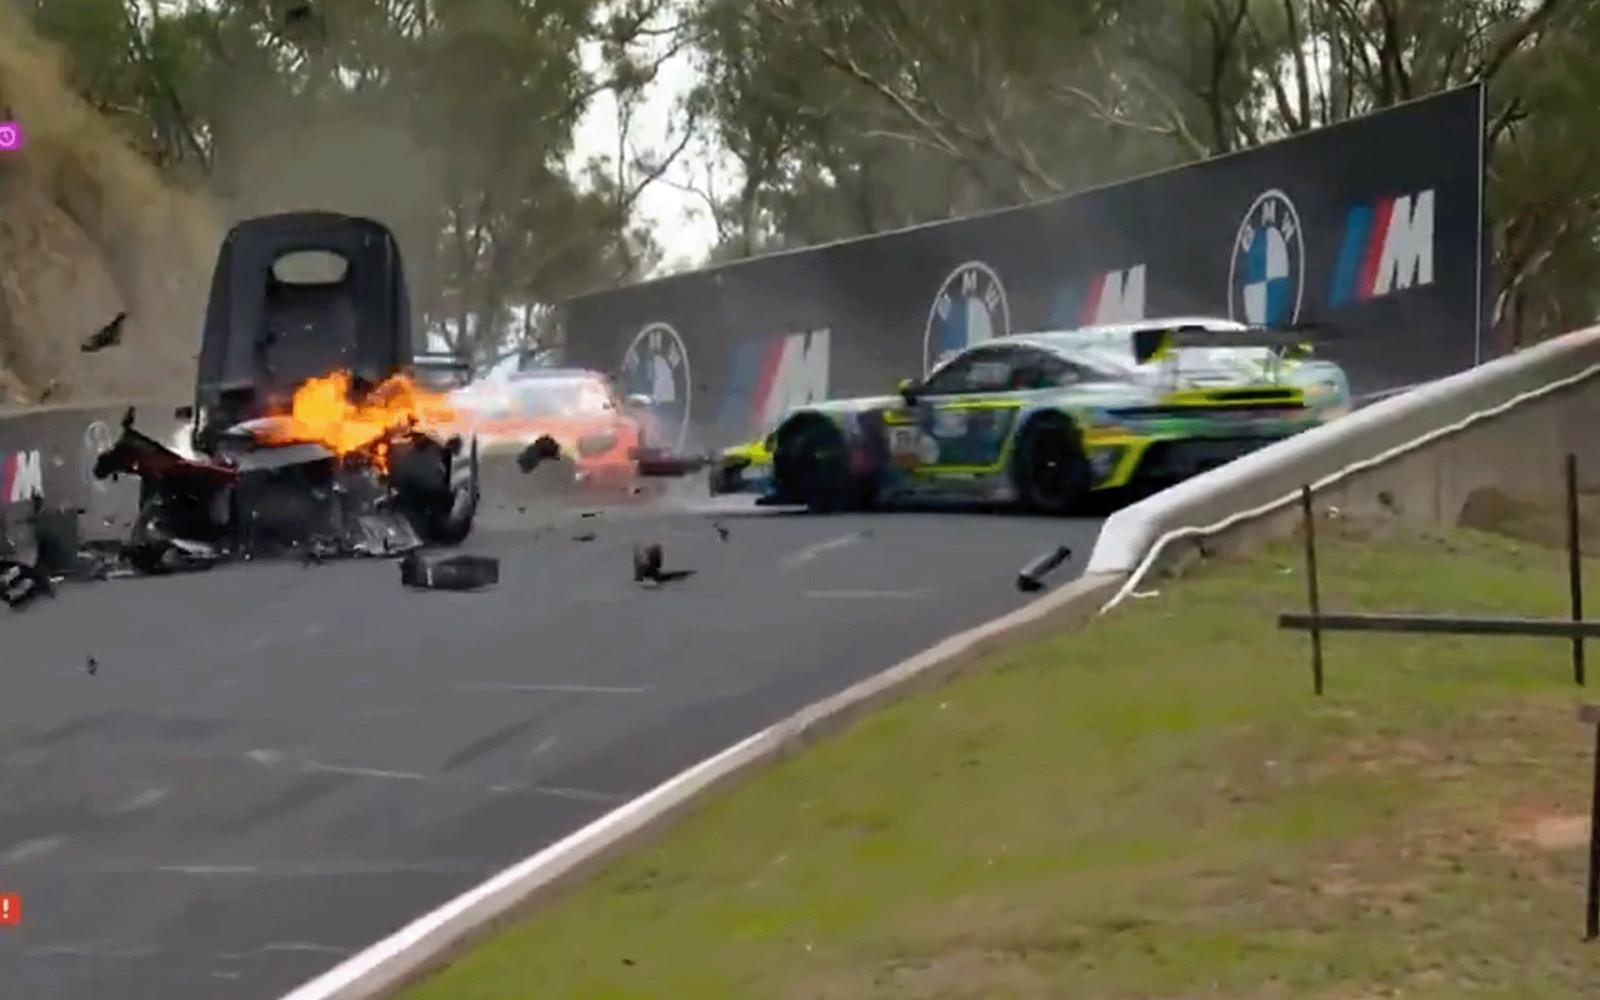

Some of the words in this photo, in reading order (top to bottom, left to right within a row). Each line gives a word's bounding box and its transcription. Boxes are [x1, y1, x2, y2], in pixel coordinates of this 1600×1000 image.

[1373, 188, 1435, 297] M
[1096, 263, 1147, 328] M
[765, 327, 831, 430] M
[10, 448, 44, 503] M
